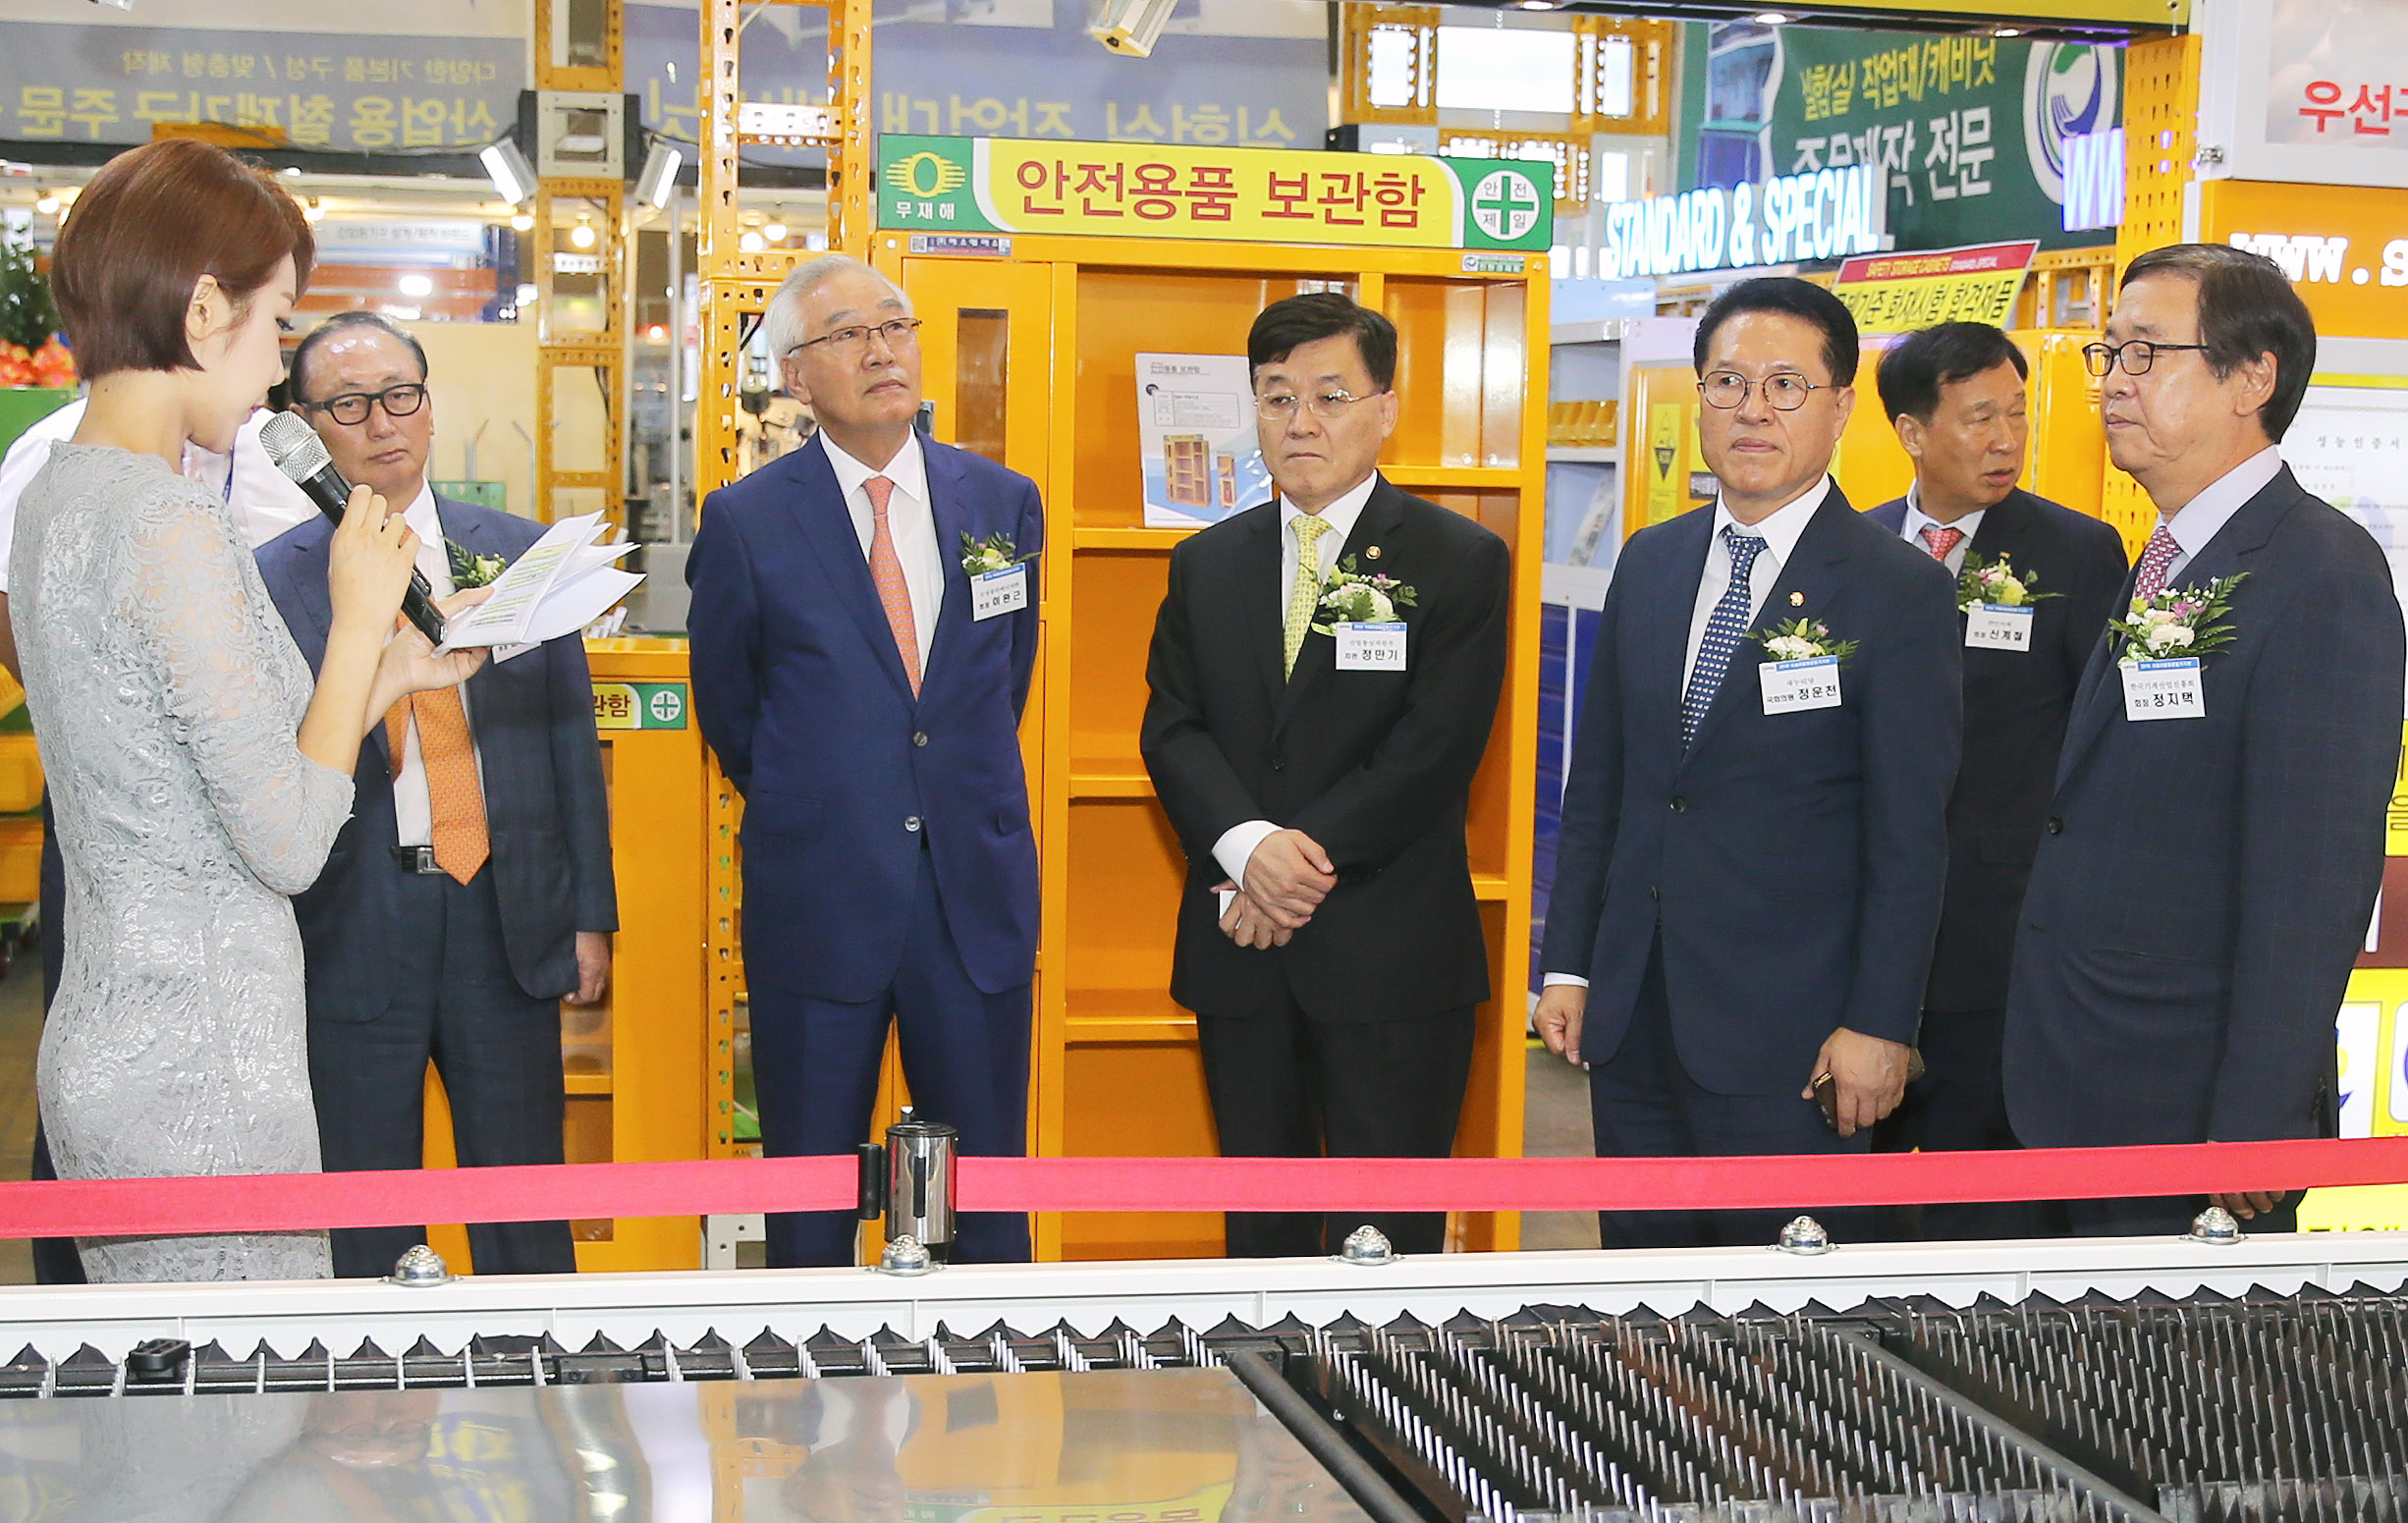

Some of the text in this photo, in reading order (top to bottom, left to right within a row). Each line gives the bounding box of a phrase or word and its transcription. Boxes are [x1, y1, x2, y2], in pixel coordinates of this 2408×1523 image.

[1924, 105, 1996, 201] 전문
[895, 200, 957, 223] 무재해
[1016, 159, 1427, 228] 안전용품 보관함
[1606, 163, 1884, 277] STANDARD & SPECIAL
[1361, 649, 1398, 661] 정만기
[2153, 691, 2195, 708] 정지택
